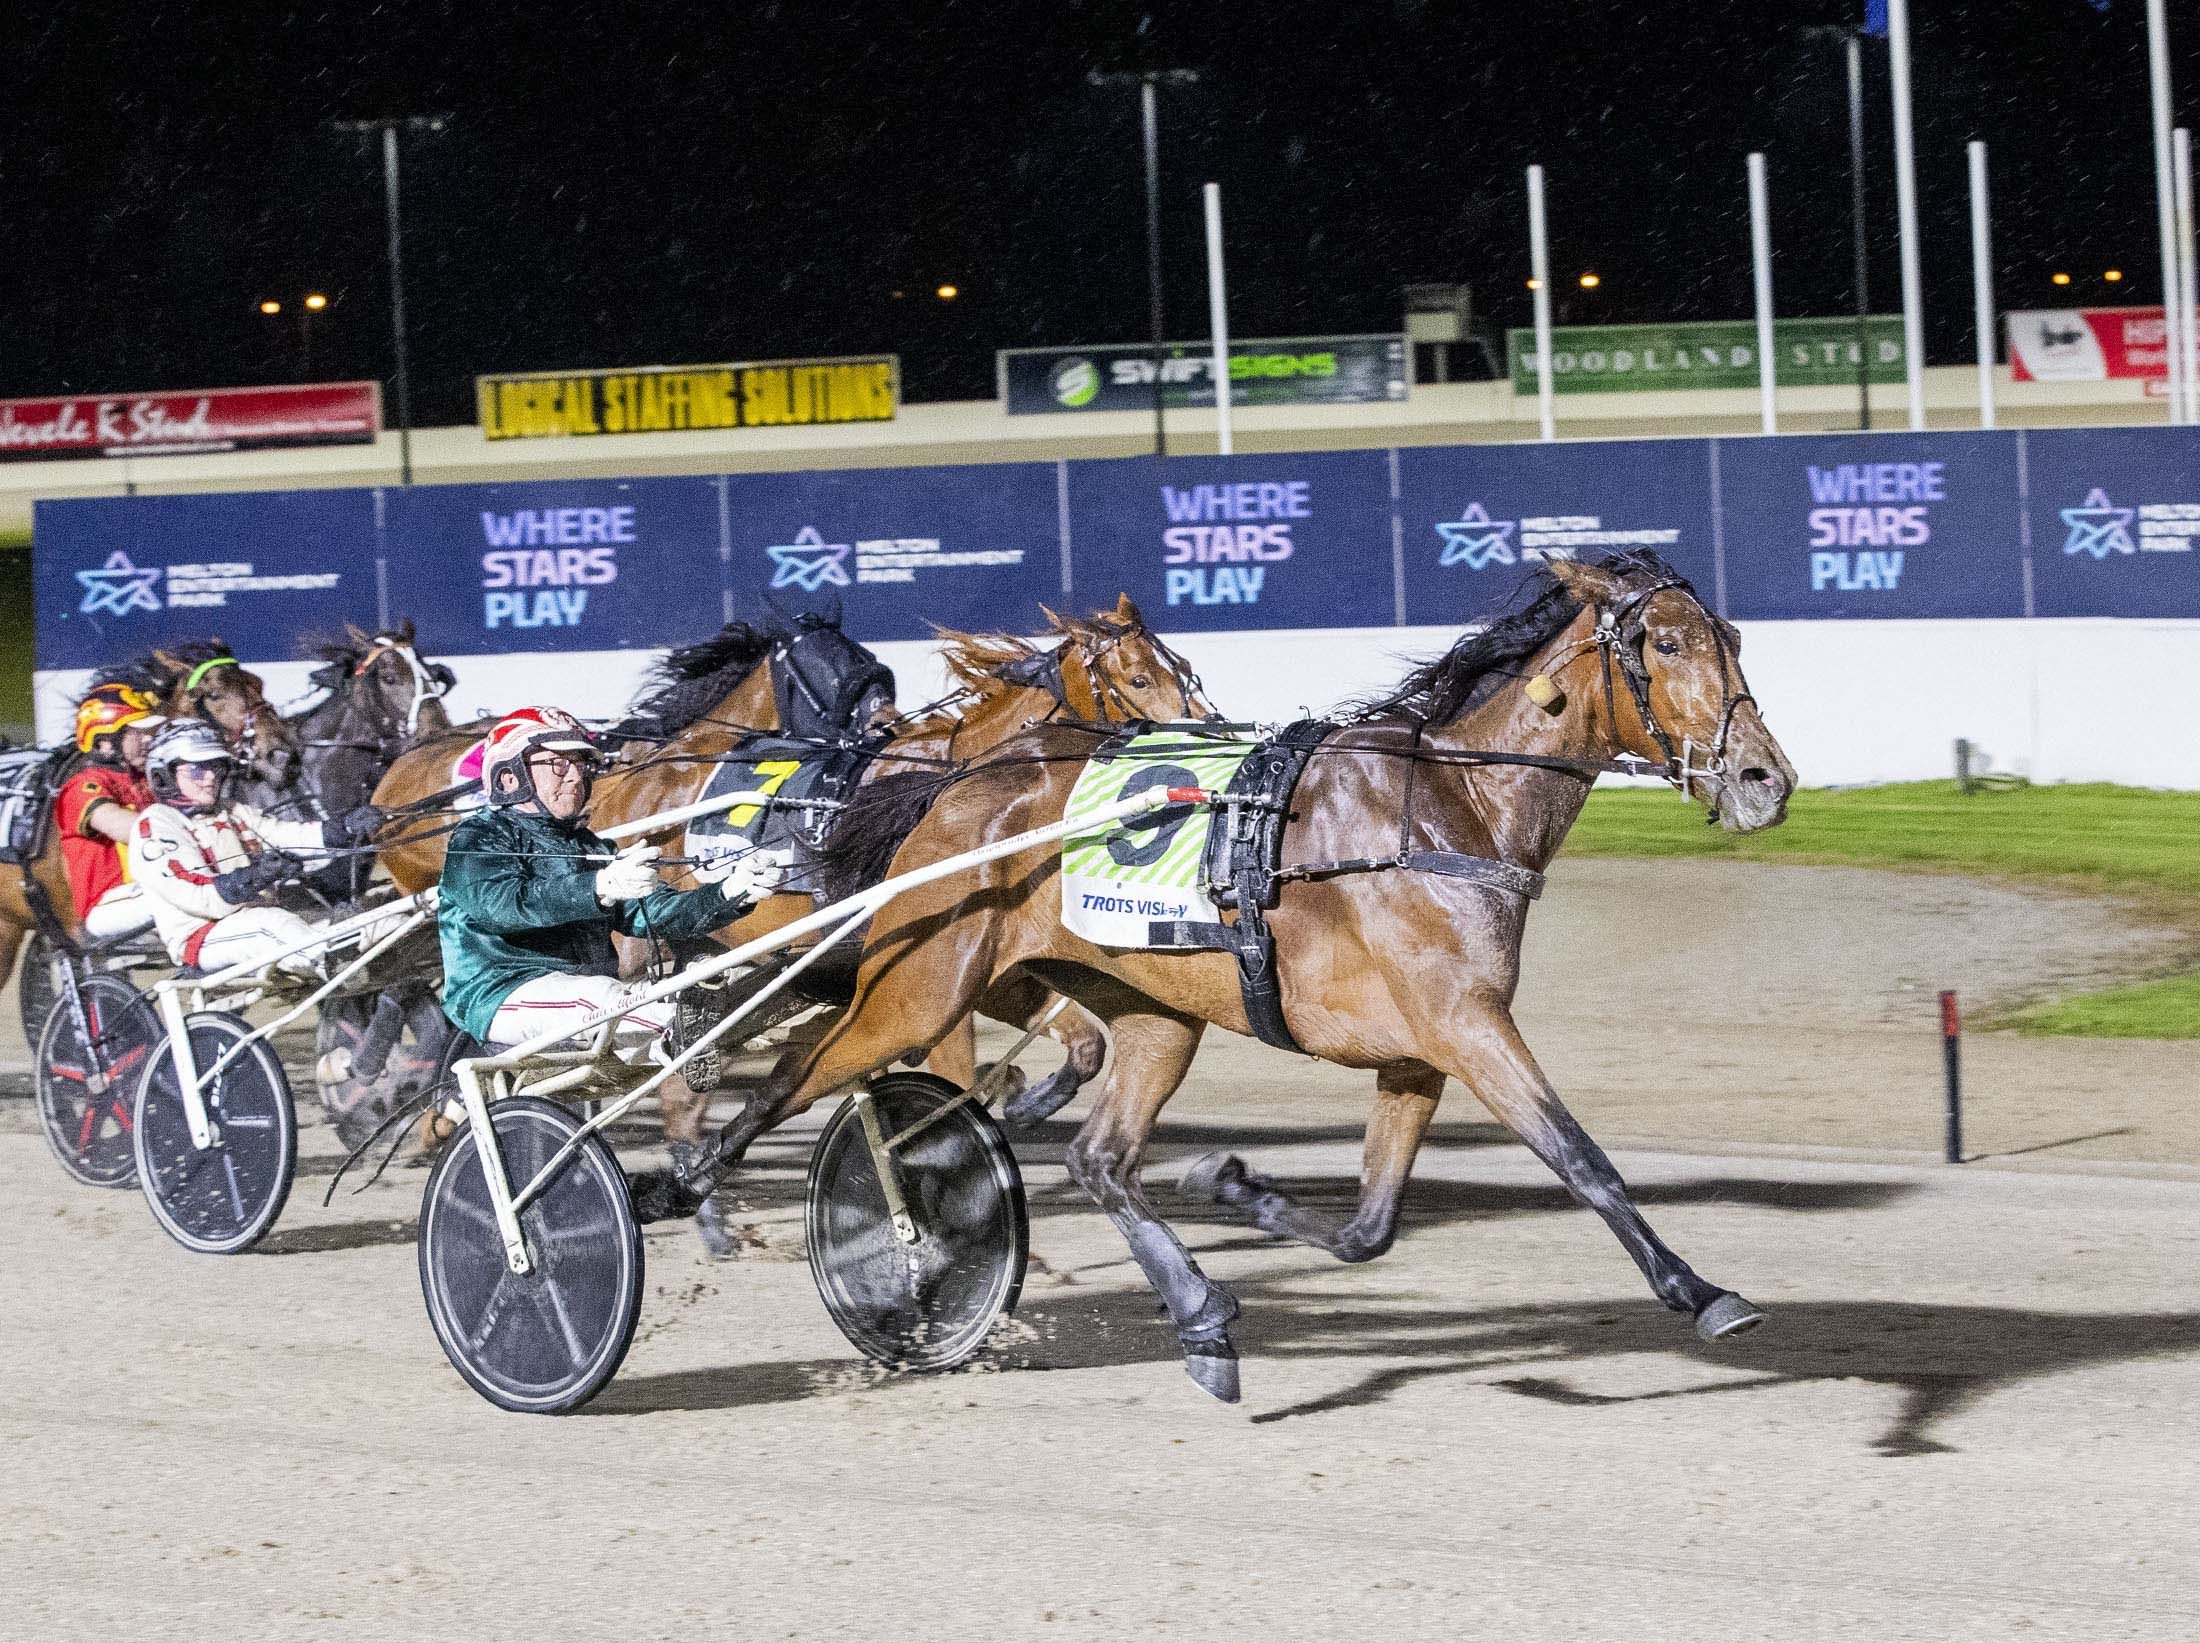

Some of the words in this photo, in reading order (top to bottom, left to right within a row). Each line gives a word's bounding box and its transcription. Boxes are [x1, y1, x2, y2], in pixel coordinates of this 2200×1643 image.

[1520, 344, 1753, 373] WOODLAND
[1793, 339, 1900, 367] STUD
[1160, 480, 1313, 522] WHERE
[1806, 462, 1946, 503] WHERE
[480, 506, 636, 546] WHERE
[1163, 524, 1294, 564] STARS
[1808, 506, 1930, 547] STARS
[482, 548, 618, 588] STARS
[1165, 566, 1264, 605] PLAY
[1811, 551, 1904, 590] PLAY
[484, 589, 588, 629] PLAY
[727, 760, 802, 828] 7
[1082, 893, 1134, 914] TROTS
